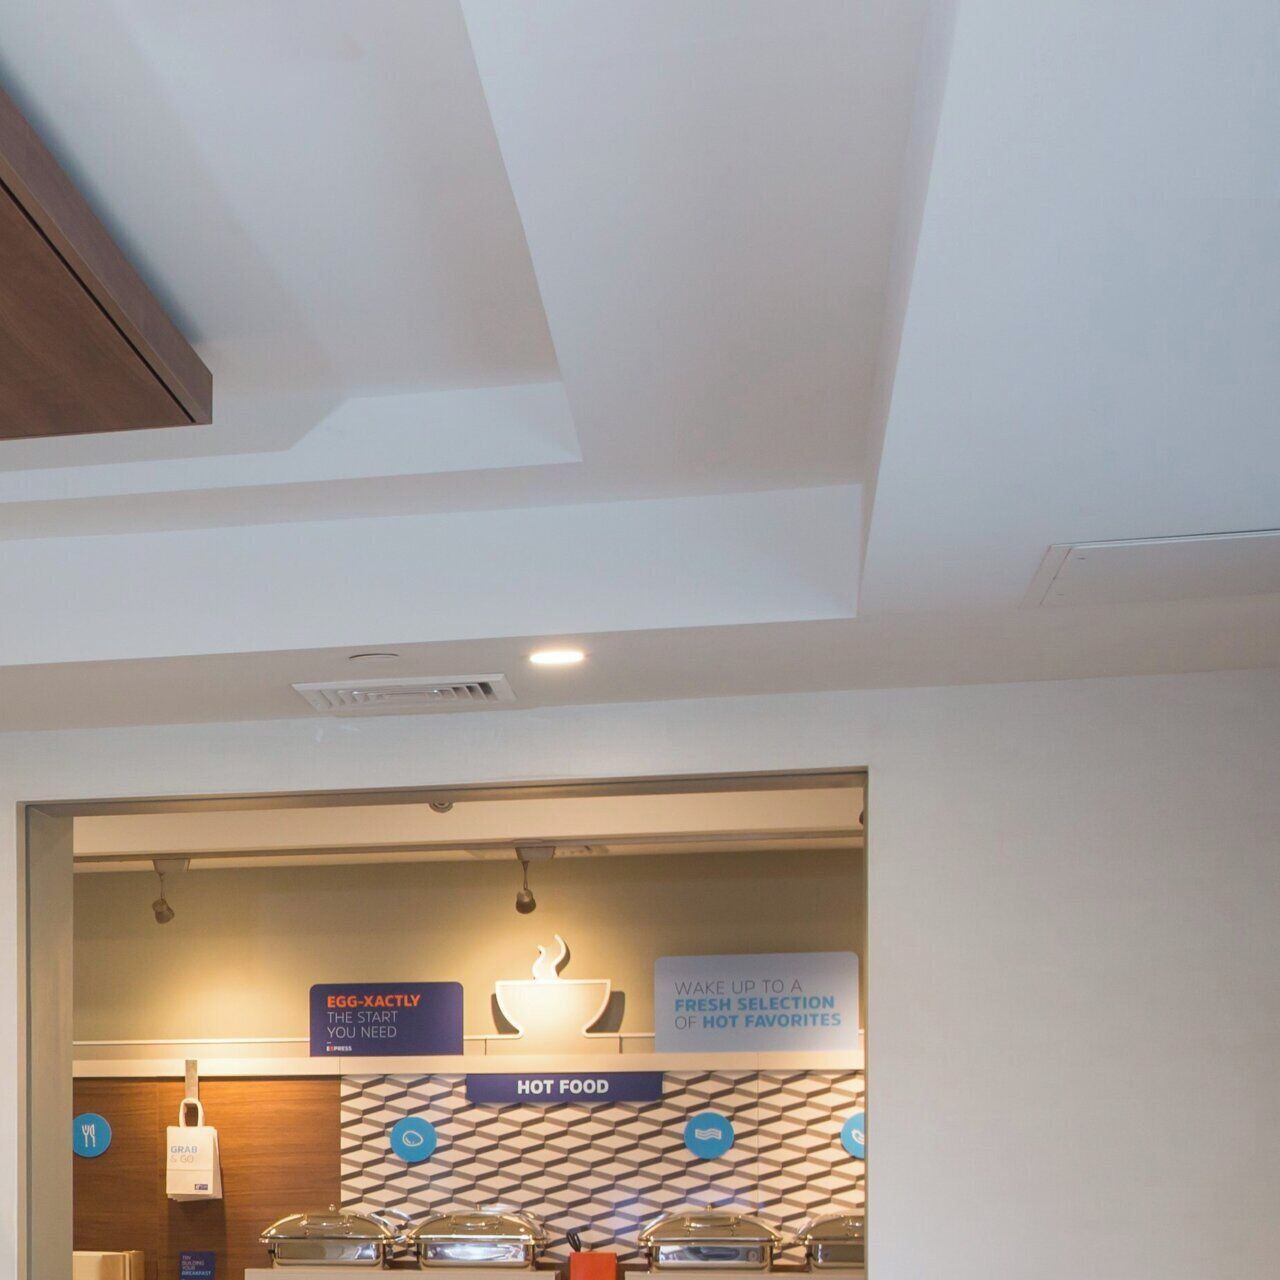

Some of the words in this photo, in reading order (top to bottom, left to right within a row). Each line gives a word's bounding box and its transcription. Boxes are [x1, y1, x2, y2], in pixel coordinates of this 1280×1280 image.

[674, 980, 725, 995] WAKE
[731, 979, 755, 994] UP
[762, 979, 784, 994] TO
[790, 978, 803, 993] A
[327, 994, 421, 1008] EGG-XACTLY
[674, 998, 731, 1012] FRESH
[737, 995, 835, 1011] SELECTION
[327, 1011, 353, 1024] THE
[357, 1010, 398, 1023] START
[674, 1015, 697, 1030] OF
[702, 1014, 739, 1029] HOT
[744, 1013, 842, 1028] FAVORITES
[327, 1026, 356, 1039] YOU
[361, 1025, 397, 1038] NEED
[517, 1079, 554, 1095] HOT
[559, 1078, 609, 1094] FOOD
[170, 1145, 198, 1154] GRAB
